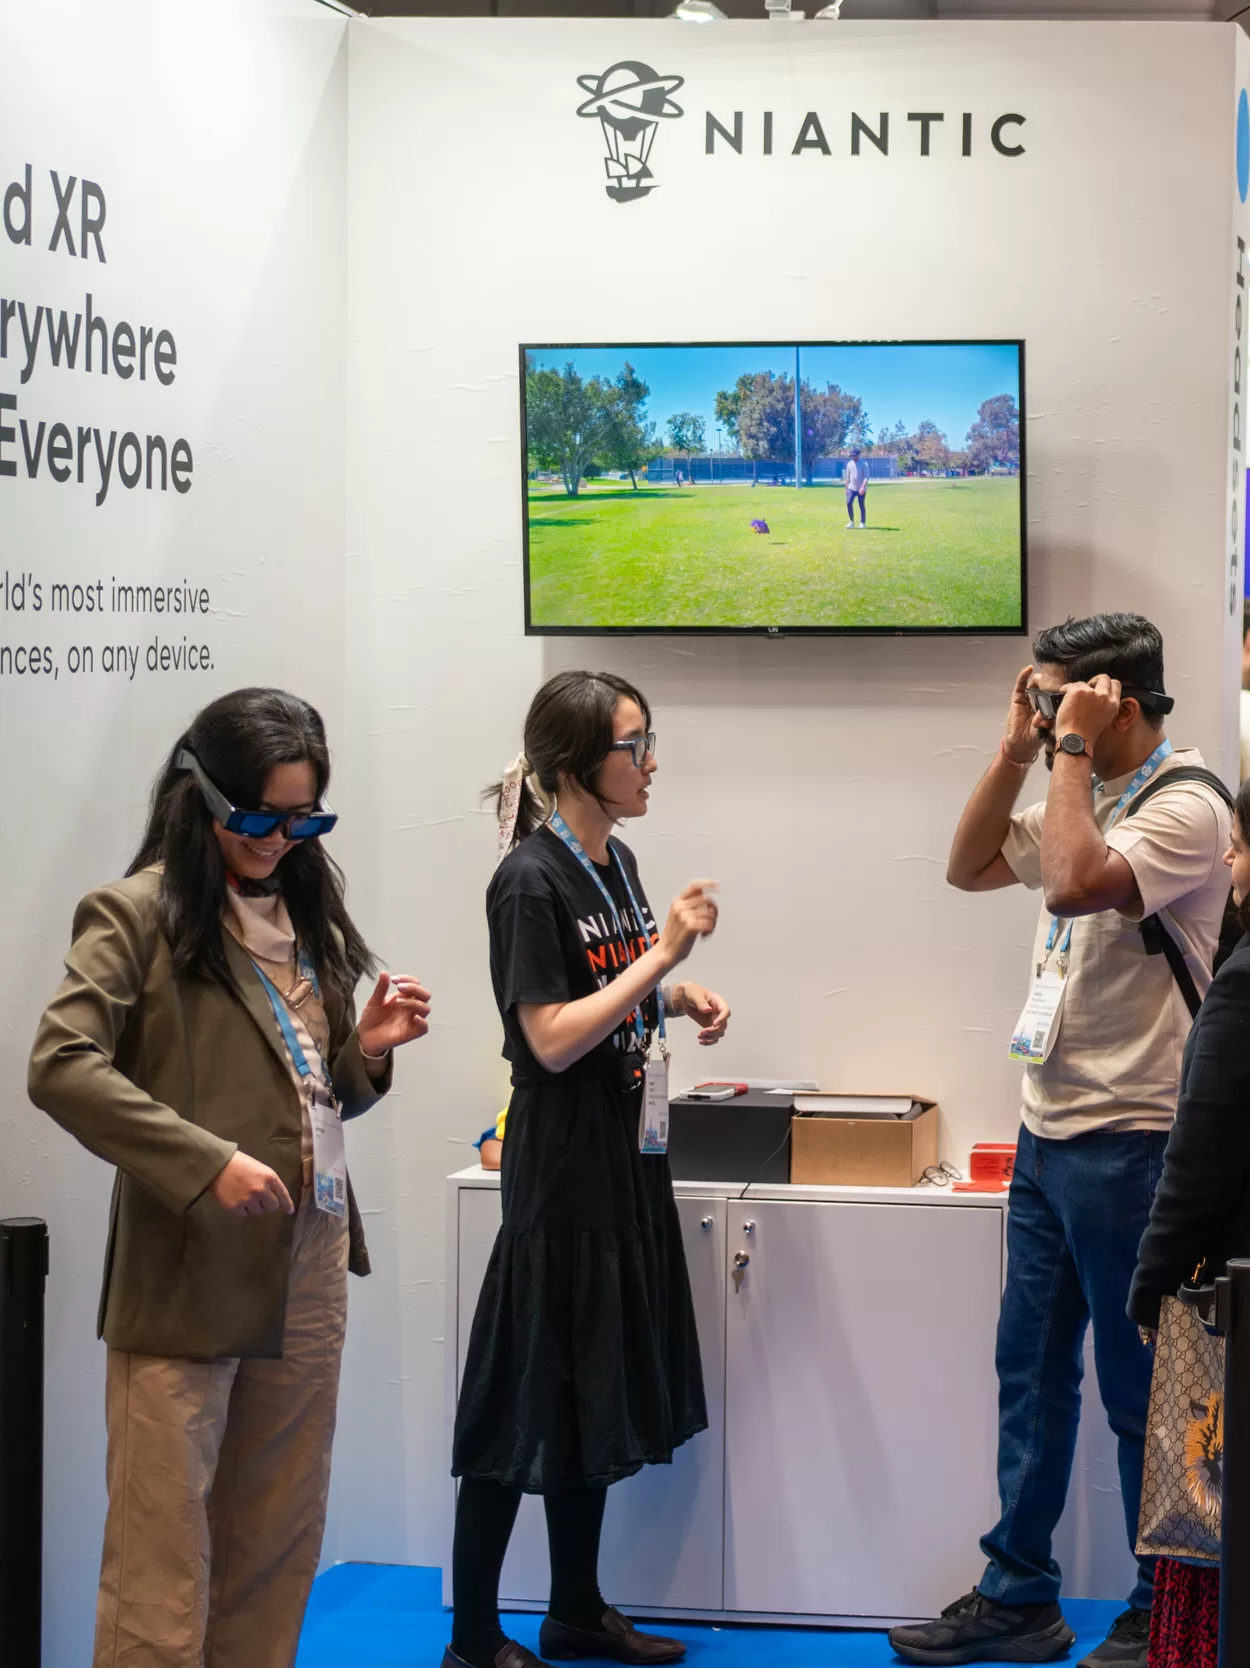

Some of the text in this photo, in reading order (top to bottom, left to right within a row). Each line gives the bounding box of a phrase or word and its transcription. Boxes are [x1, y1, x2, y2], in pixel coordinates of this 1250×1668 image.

[705, 111, 1027, 157] NIANTIC
[48, 169, 107, 264] XR
[0, 293, 178, 387] rywhere
[0, 394, 194, 507] Everyone
[1229, 235, 1246, 617] Headsets
[0, 570, 210, 613] ld's most immersive
[68, 645, 94, 673] on
[102, 645, 139, 680] any
[146, 635, 214, 671] device.
